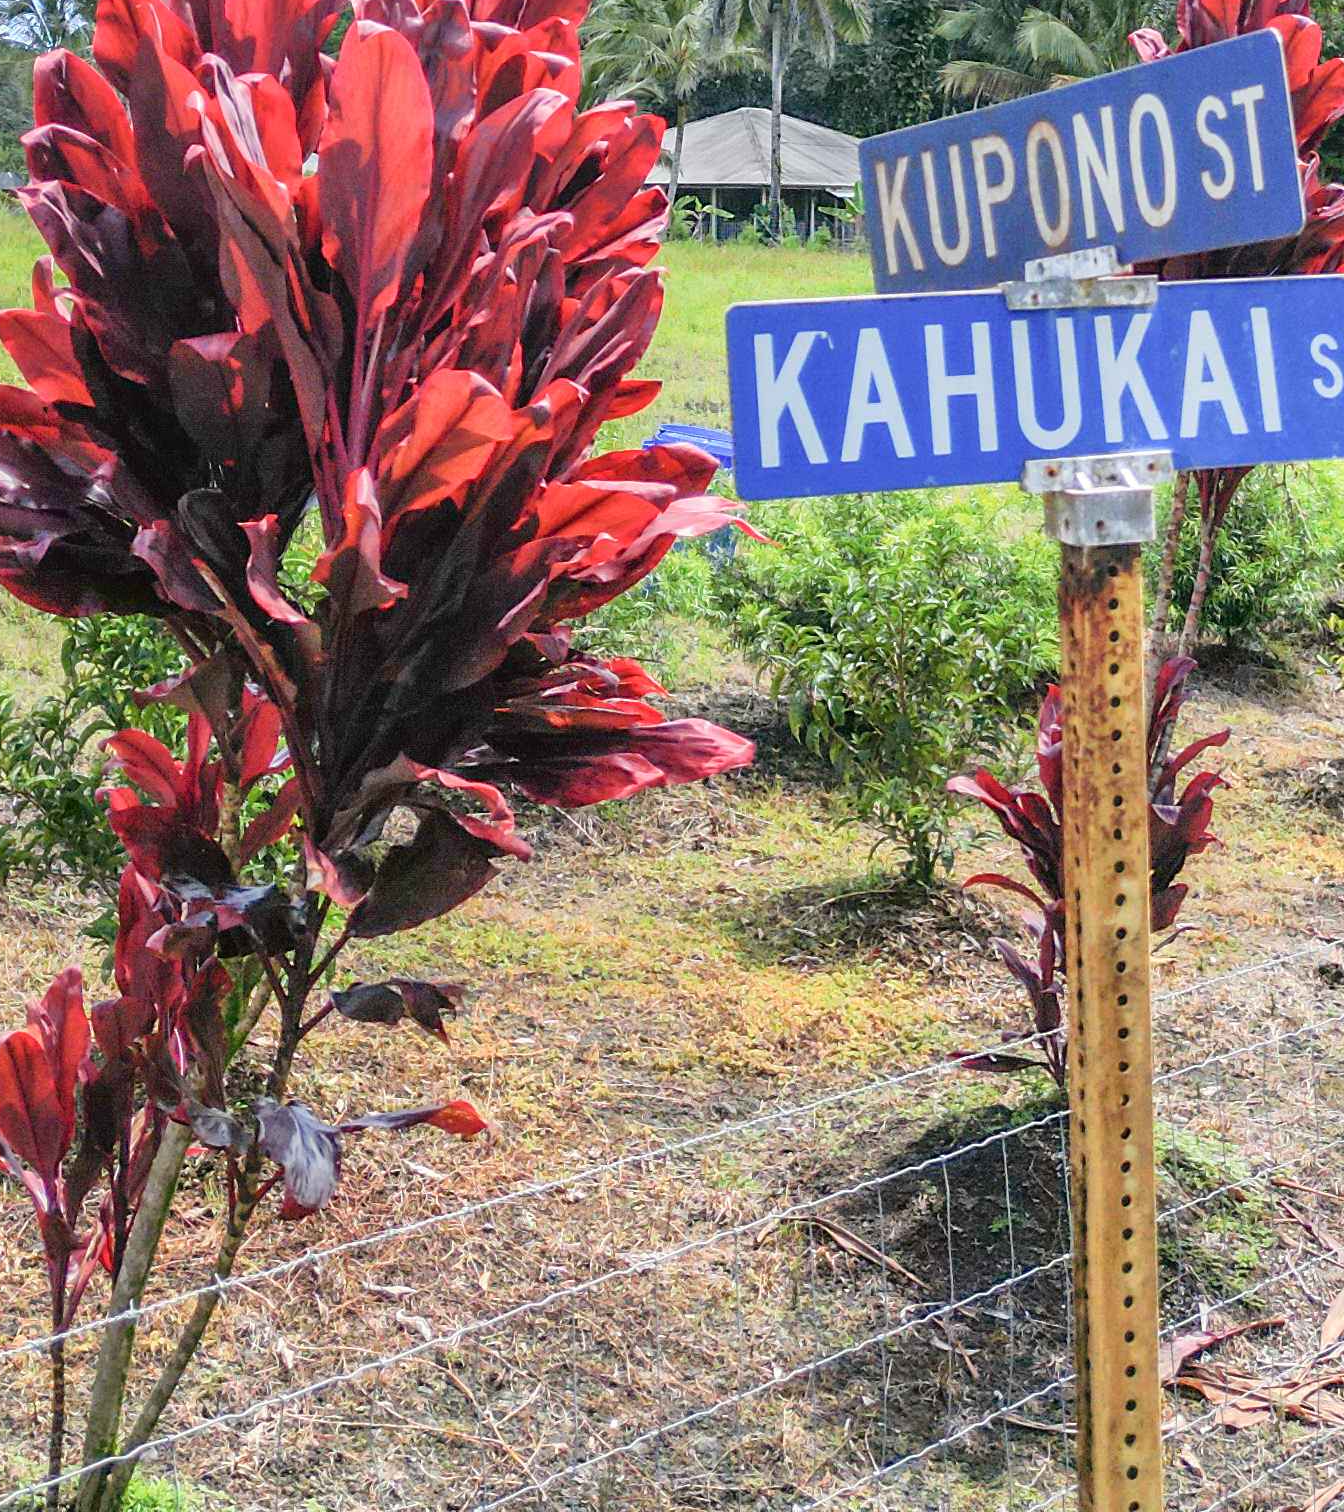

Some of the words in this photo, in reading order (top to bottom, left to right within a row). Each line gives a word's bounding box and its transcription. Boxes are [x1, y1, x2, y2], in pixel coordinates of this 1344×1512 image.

[874, 93, 1176, 274] KUPONO
[1196, 85, 1265, 201] ST
[753, 307, 1283, 469] KAHUKAI
